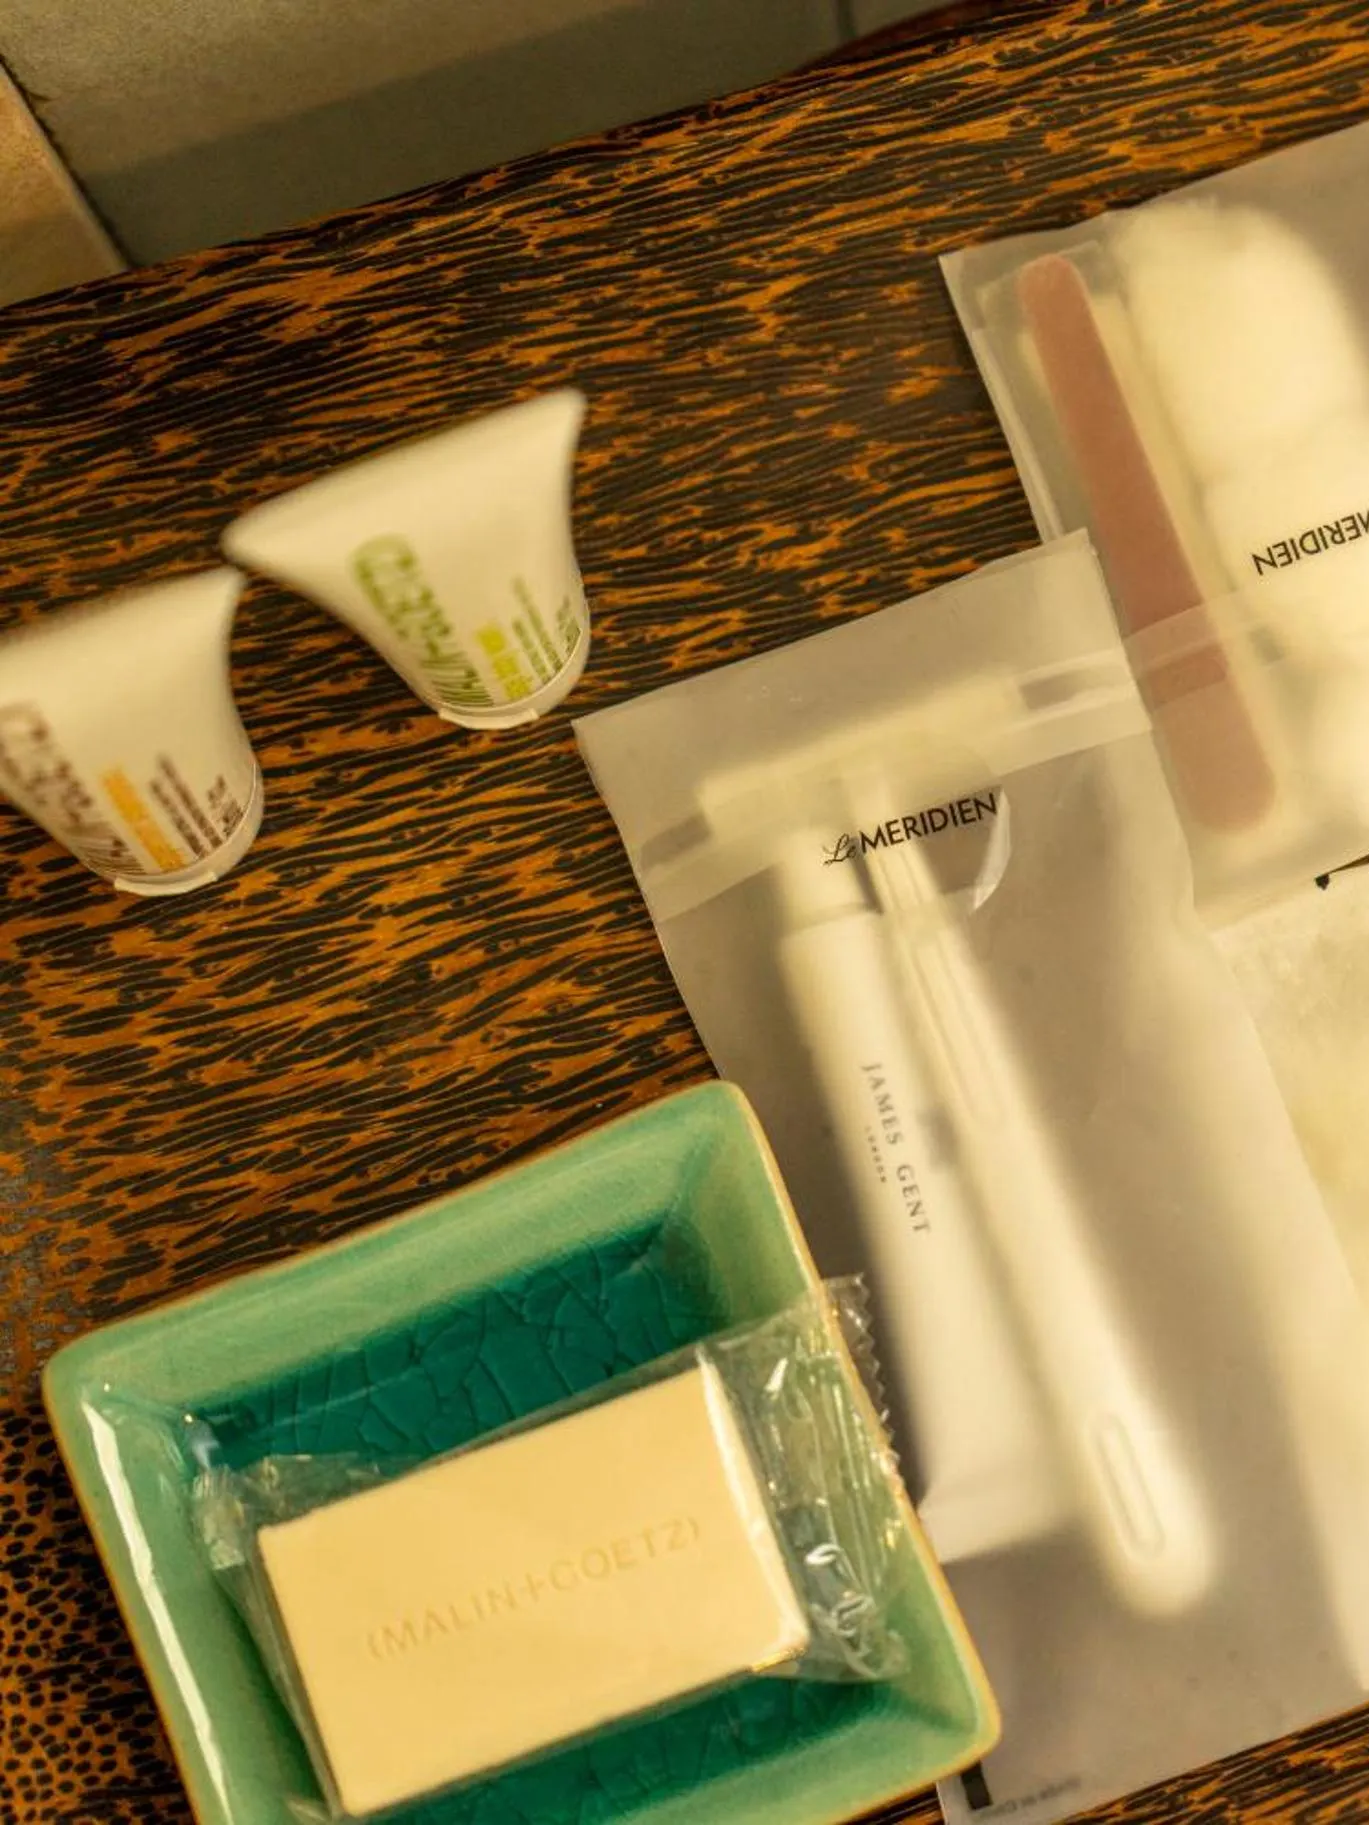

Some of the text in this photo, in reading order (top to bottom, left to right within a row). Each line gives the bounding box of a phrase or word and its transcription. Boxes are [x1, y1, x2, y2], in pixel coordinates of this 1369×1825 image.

[859, 792, 997, 853] MERIDIEN
[861, 1062, 903, 1145] JAMES
[896, 1163, 931, 1234] GENT
